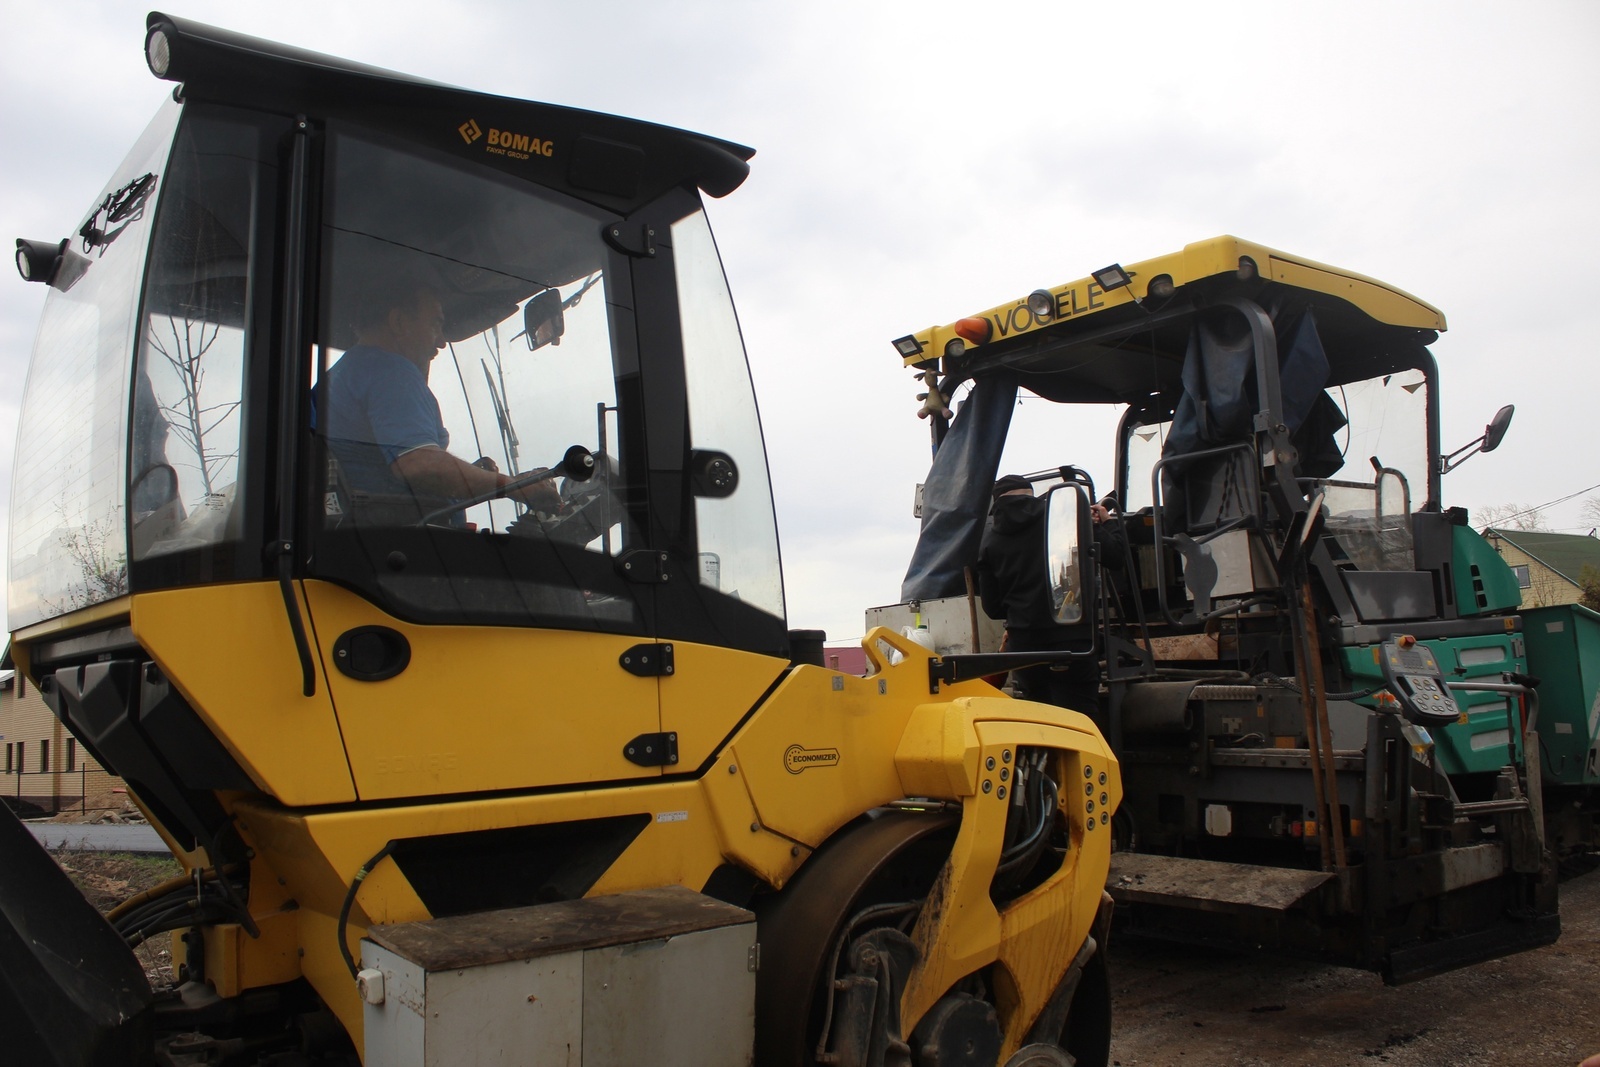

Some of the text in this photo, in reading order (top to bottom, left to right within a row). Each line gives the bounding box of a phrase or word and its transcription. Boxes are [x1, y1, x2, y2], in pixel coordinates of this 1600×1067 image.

[487, 128, 553, 157] BOMAG
[486, 146, 529, 160] FAYAT GROUP
[793, 754, 836, 762] ECONOMIZER
